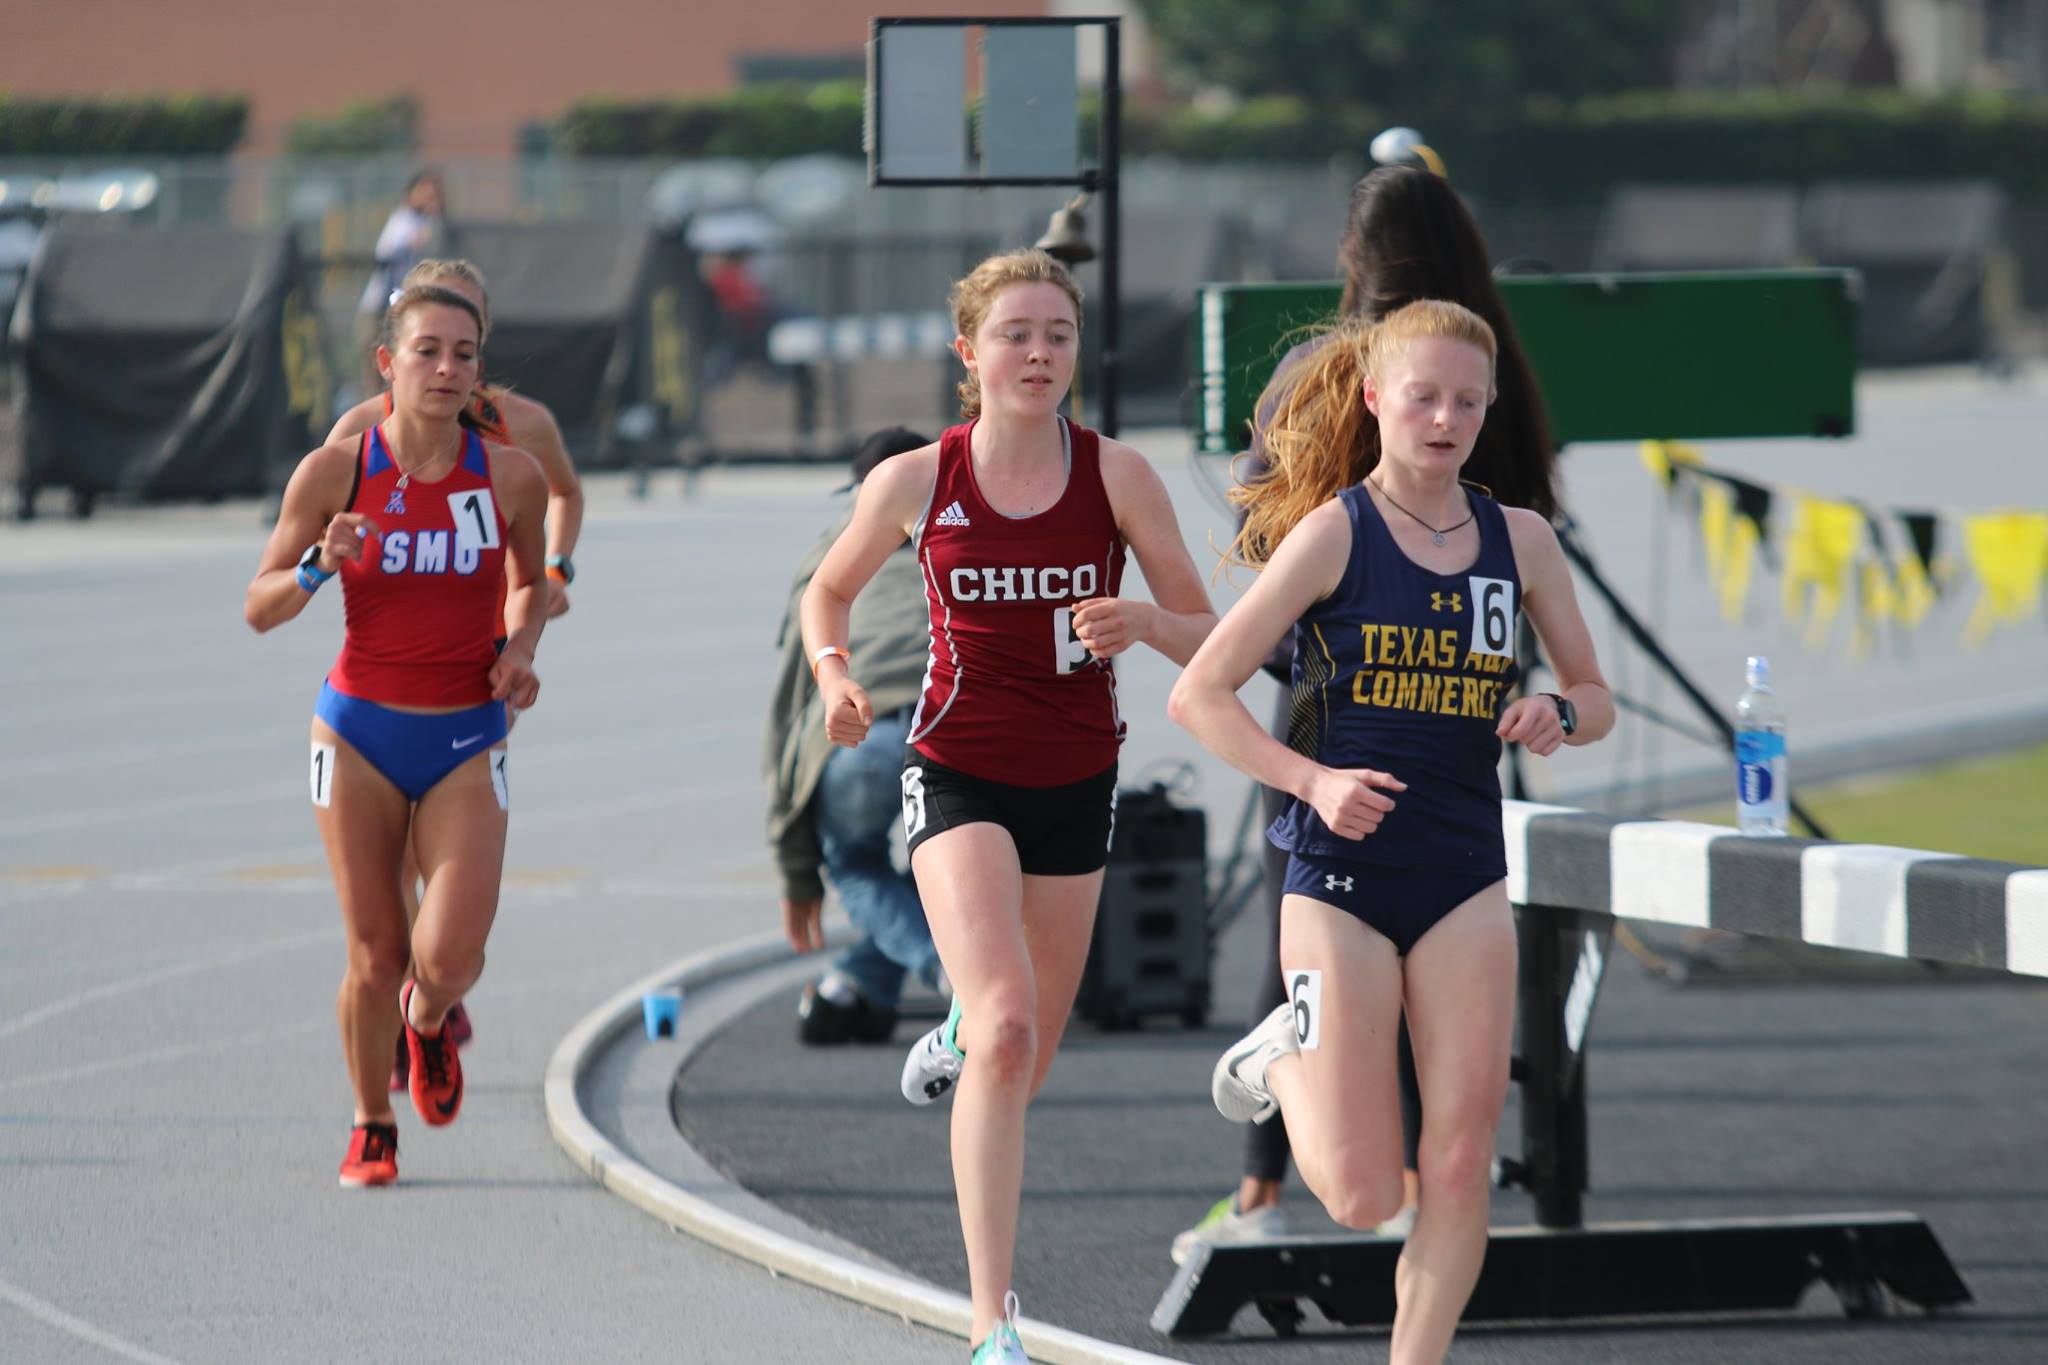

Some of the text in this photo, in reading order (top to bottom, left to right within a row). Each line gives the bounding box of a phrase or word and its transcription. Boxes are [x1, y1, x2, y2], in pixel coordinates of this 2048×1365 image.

[463, 494, 488, 544] 1
[935, 515, 970, 527] adidas
[381, 529, 480, 575] SMU
[950, 564, 1097, 602] CHICO
[1483, 582, 1507, 652] 6
[1360, 624, 1459, 668] TEXAS
[314, 750, 325, 801] 1
[1292, 974, 1310, 1045] 6
